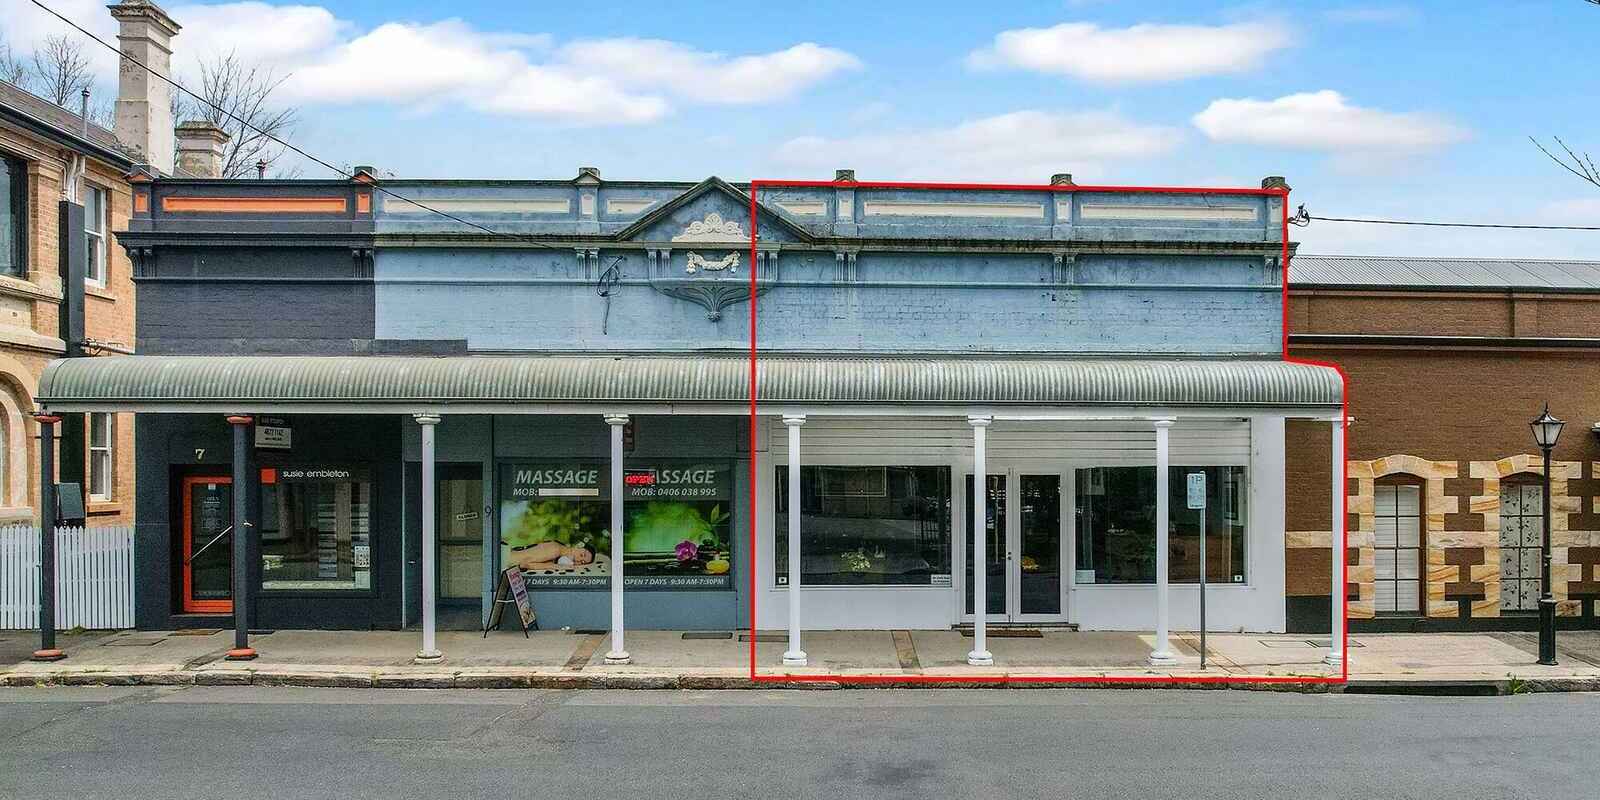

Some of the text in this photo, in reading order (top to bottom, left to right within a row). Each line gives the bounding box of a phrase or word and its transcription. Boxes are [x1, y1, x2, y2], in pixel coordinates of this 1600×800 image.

[195, 448, 206, 460] 7
[283, 469, 350, 478] susie embleton
[515, 470, 598, 485] MASSAGE
[656, 470, 716, 484] SSAGE
[513, 487, 538, 497] MOB:
[631, 487, 718, 497] MOB: 0406 038 995
[485, 505, 492, 517] 9
